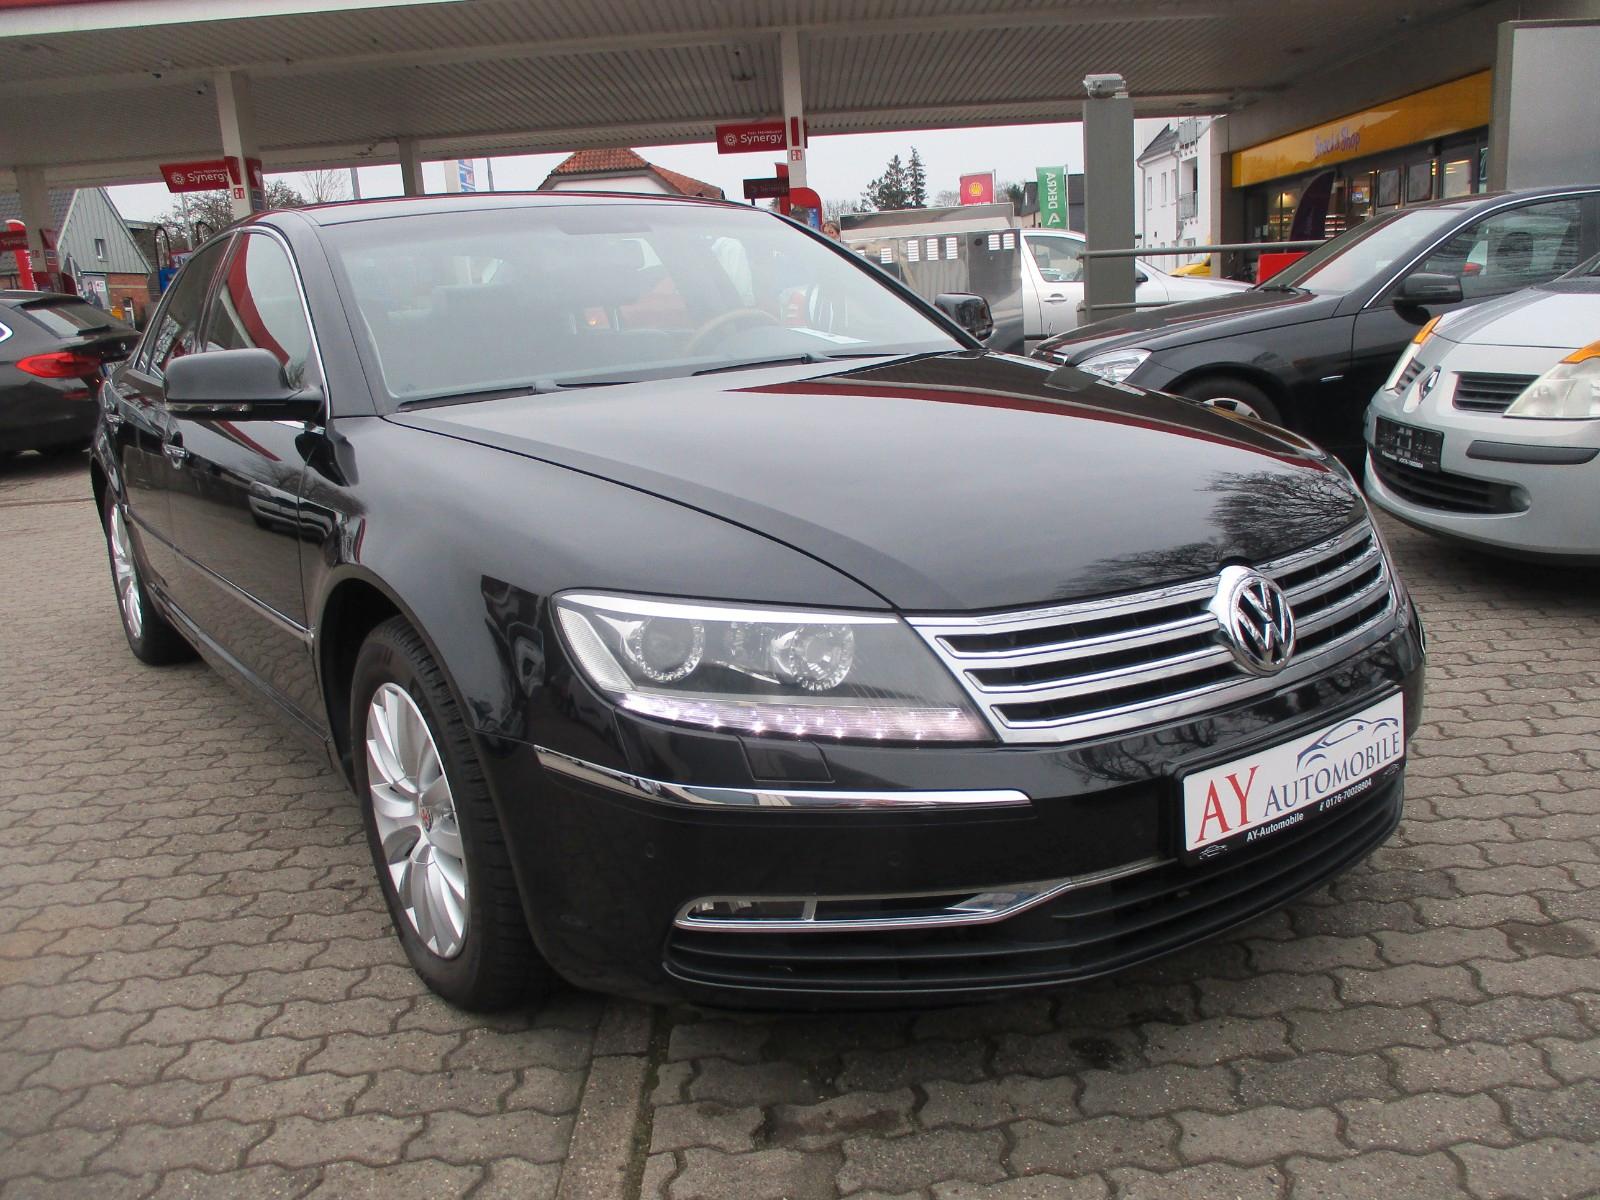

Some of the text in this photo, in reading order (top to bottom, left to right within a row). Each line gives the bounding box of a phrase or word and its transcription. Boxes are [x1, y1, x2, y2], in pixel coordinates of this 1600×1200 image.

[740, 134, 783, 145] Synergy
[1046, 172, 1058, 209] DEKRA
[1195, 731, 1400, 844] AY AUTOMOBILE
[1246, 812, 1304, 843] AY-Automobile
